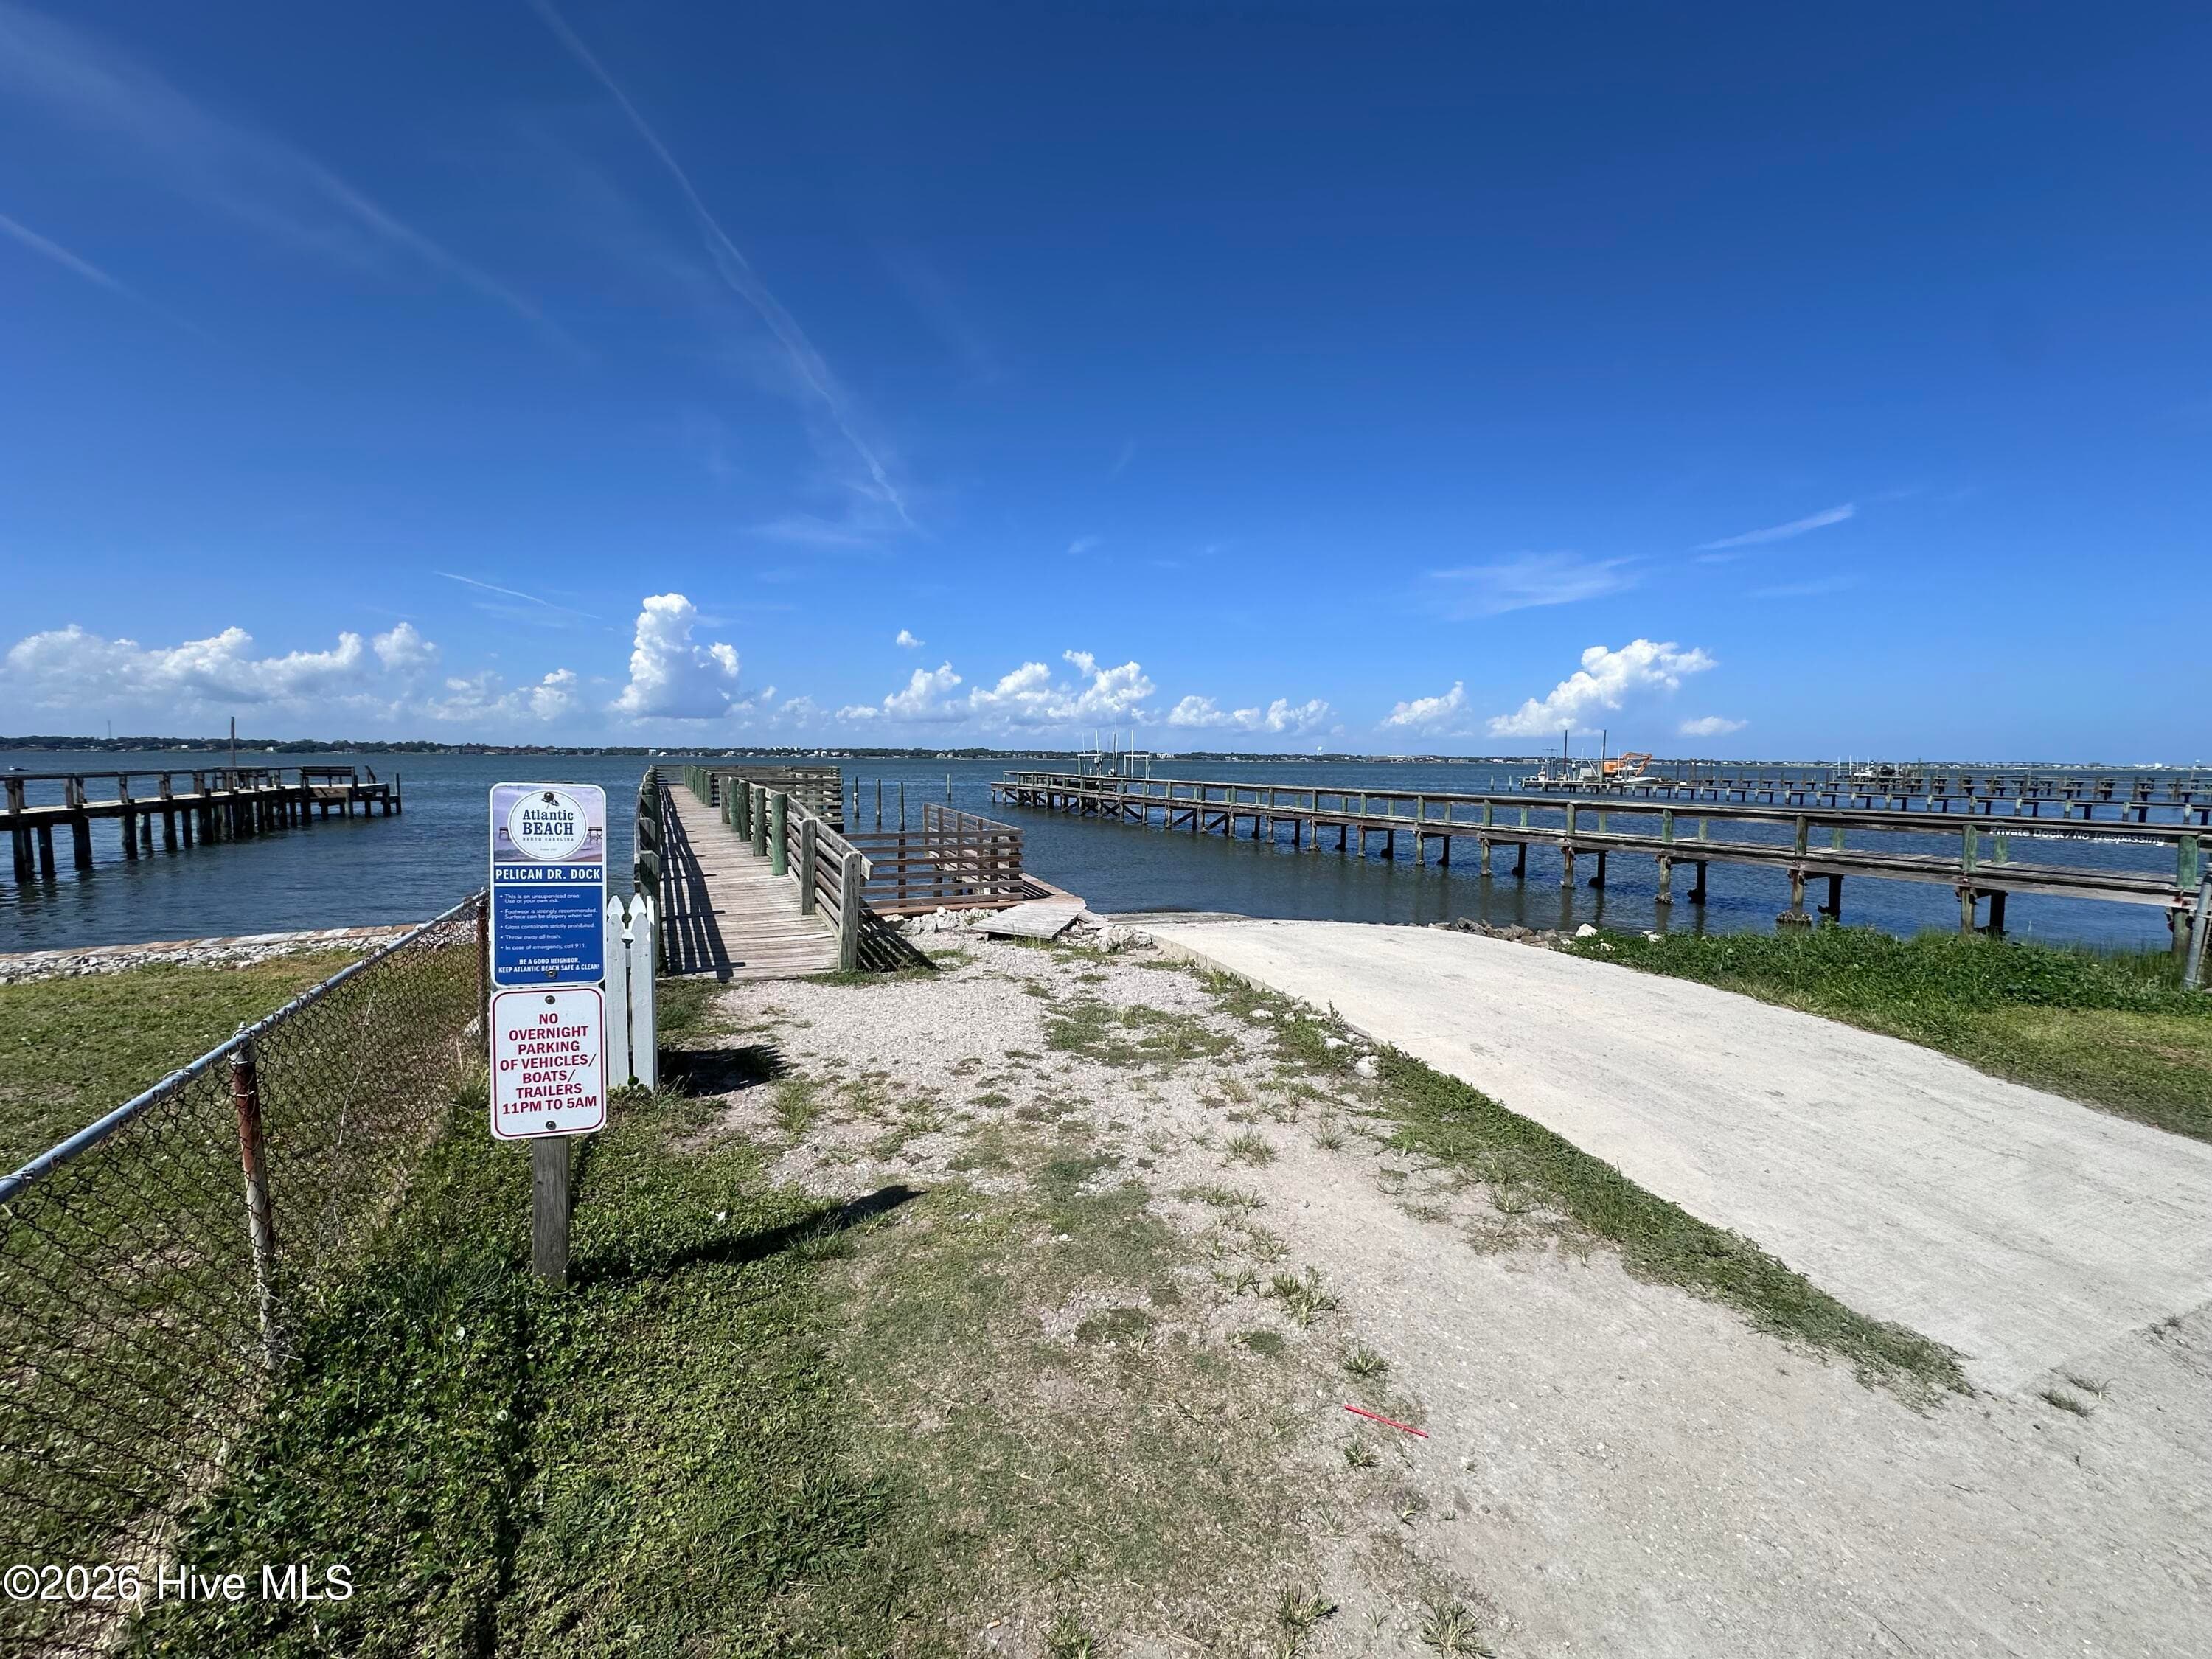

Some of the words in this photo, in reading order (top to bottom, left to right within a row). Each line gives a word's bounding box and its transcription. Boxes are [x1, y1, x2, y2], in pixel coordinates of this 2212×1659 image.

[523, 809, 574, 820] Atlantic
[523, 822, 574, 835] BEACH
[1989, 826, 2030, 836] Private
[2093, 831, 2165, 846] Trespassing
[495, 869, 542, 880] PELICAN
[547, 869, 566, 880] DR.
[571, 869, 600, 880] DOCK
[539, 1013, 558, 1025] NO
[509, 1026, 588, 1041] OVERNIGHT
[518, 1040, 580, 1055] PARKING
[500, 1059, 518, 1071] OF
[521, 1054, 596, 1069] VEHICLES/
[523, 1069, 576, 1083] BOATS/
[516, 1083, 582, 1099] TRAILERS
[503, 1101, 541, 1114] 11PM
[545, 1099, 563, 1110] TO
[567, 1096, 597, 1109] 5AM
